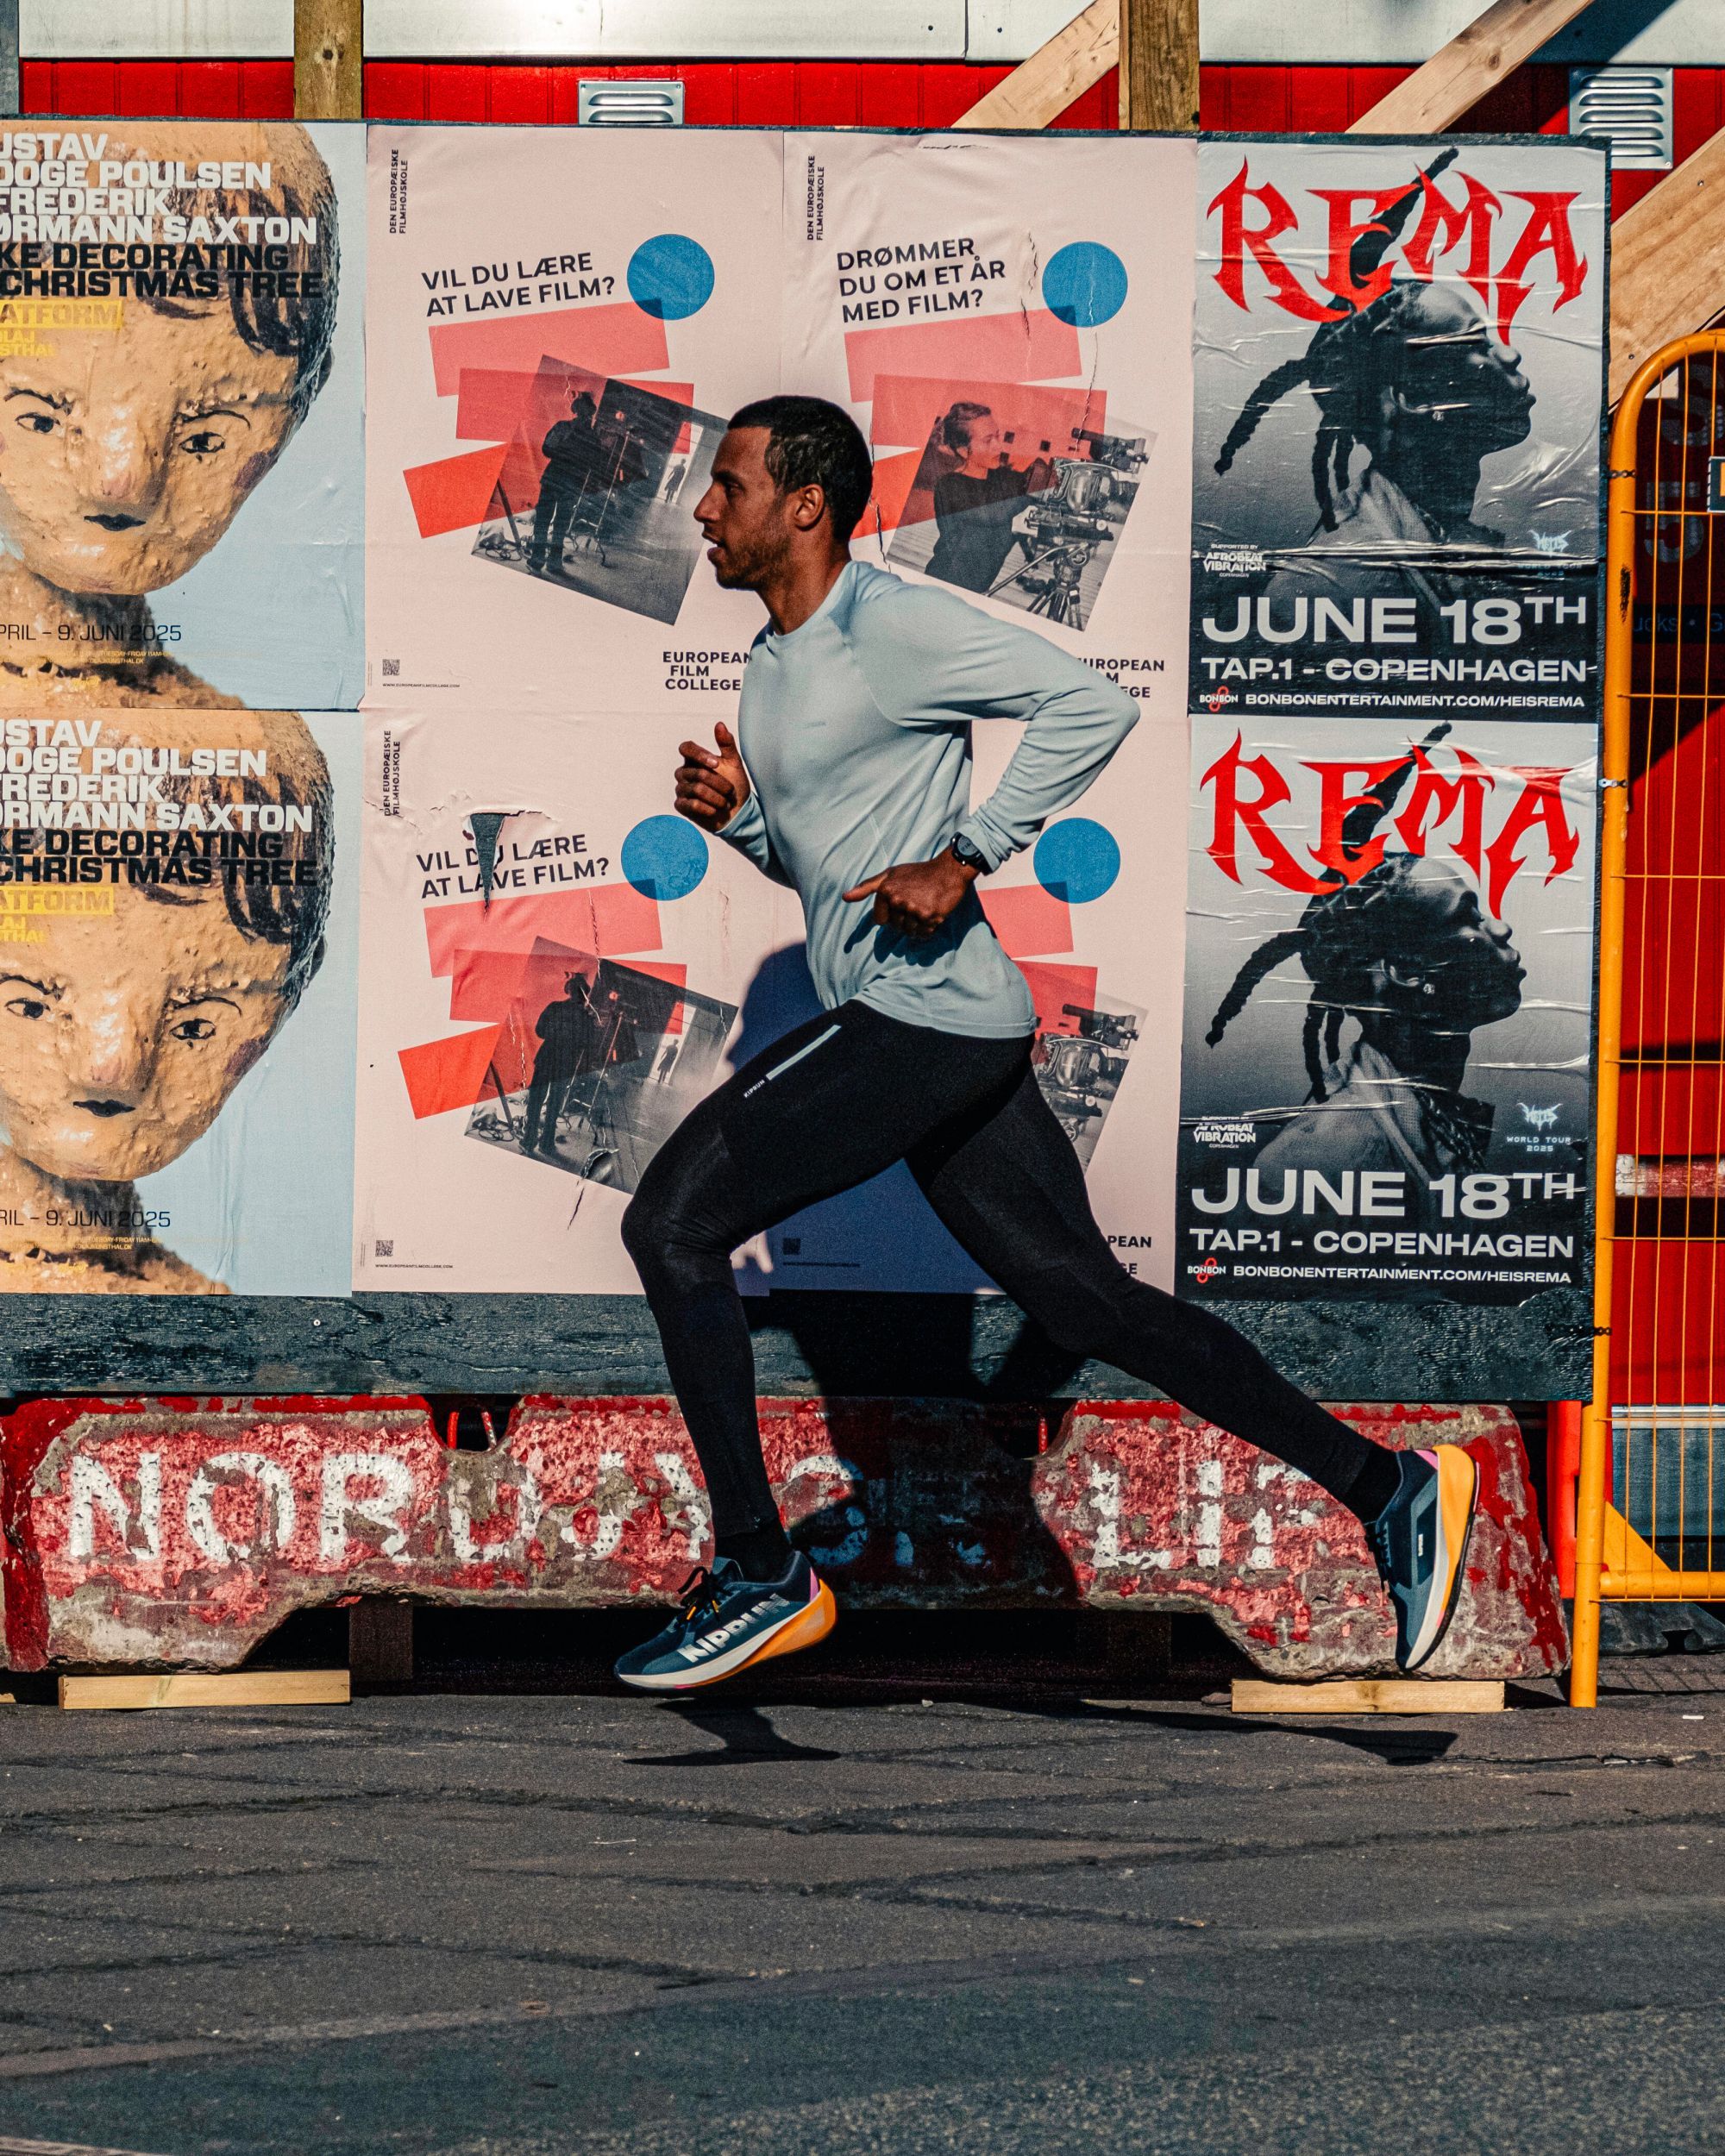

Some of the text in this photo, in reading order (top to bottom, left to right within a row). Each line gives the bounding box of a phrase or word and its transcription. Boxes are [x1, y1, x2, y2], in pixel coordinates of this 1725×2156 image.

[99, 161, 271, 189] POULSEN
[390, 149, 398, 210] EUROPÆISKE
[163, 216, 317, 245] SAXTON
[53, 243, 289, 271] DECORATING
[837, 237, 975, 271] DRØMMER
[1207, 154, 1589, 347] REMA
[0, 269, 323, 298] CHRISTMAS TREE
[421, 252, 593, 291] VIL DU LÆRE
[839, 255, 1007, 297] DU OM ET ÅR
[426, 276, 615, 317] AT LAVE FILM?
[842, 288, 983, 323] MED FILM?
[0, 303, 118, 324] ATFORM
[0, 329, 35, 343] LAJ
[1202, 561, 1266, 573] VIBRATION
[58, 624, 74, 641] 9.
[80, 624, 123, 641] JUNI
[129, 624, 182, 642] 2025
[1201, 596, 1586, 645] JUNE 18TH
[662, 651, 751, 664] EUROPEAN
[670, 665, 710, 677] FILM
[1078, 658, 1164, 672] ROPEAN
[1201, 657, 1293, 680] TAP.1
[1325, 658, 1587, 682] COPENHAGEN
[665, 678, 741, 691] COLLEGE
[1199, 694, 1585, 707] BONBON BONBONENTERTAINMENT.COM/HEISREMA
[0, 719, 103, 747] STAV
[0, 747, 267, 776] OGE POULSEN
[0, 774, 166, 802] REDERIK
[0, 800, 313, 833] RMANN SAXTON
[383, 795, 392, 817] DEN
[1200, 727, 1581, 920] REMA
[45, 829, 285, 858] DECORATING
[417, 851, 460, 873] VIL
[513, 834, 588, 862] LÆRE
[0, 856, 318, 887] CHRISTMAS TREE
[421, 856, 609, 899] AT LAVE FILM?
[1193, 1131, 1257, 1144] VIBRATION
[1191, 1168, 1575, 1219] JUNE 18TH
[46, 1210, 62, 1226] 9.
[68, 1210, 112, 1227] JUNI
[118, 1211, 171, 1227] 2025
[1189, 1228, 1281, 1252] TAP.1
[1314, 1231, 1574, 1258] COPENHAGEN
[1187, 1264, 1571, 1283] BONBON BONBONENTERTAINMENT.COM/HEISREMA
